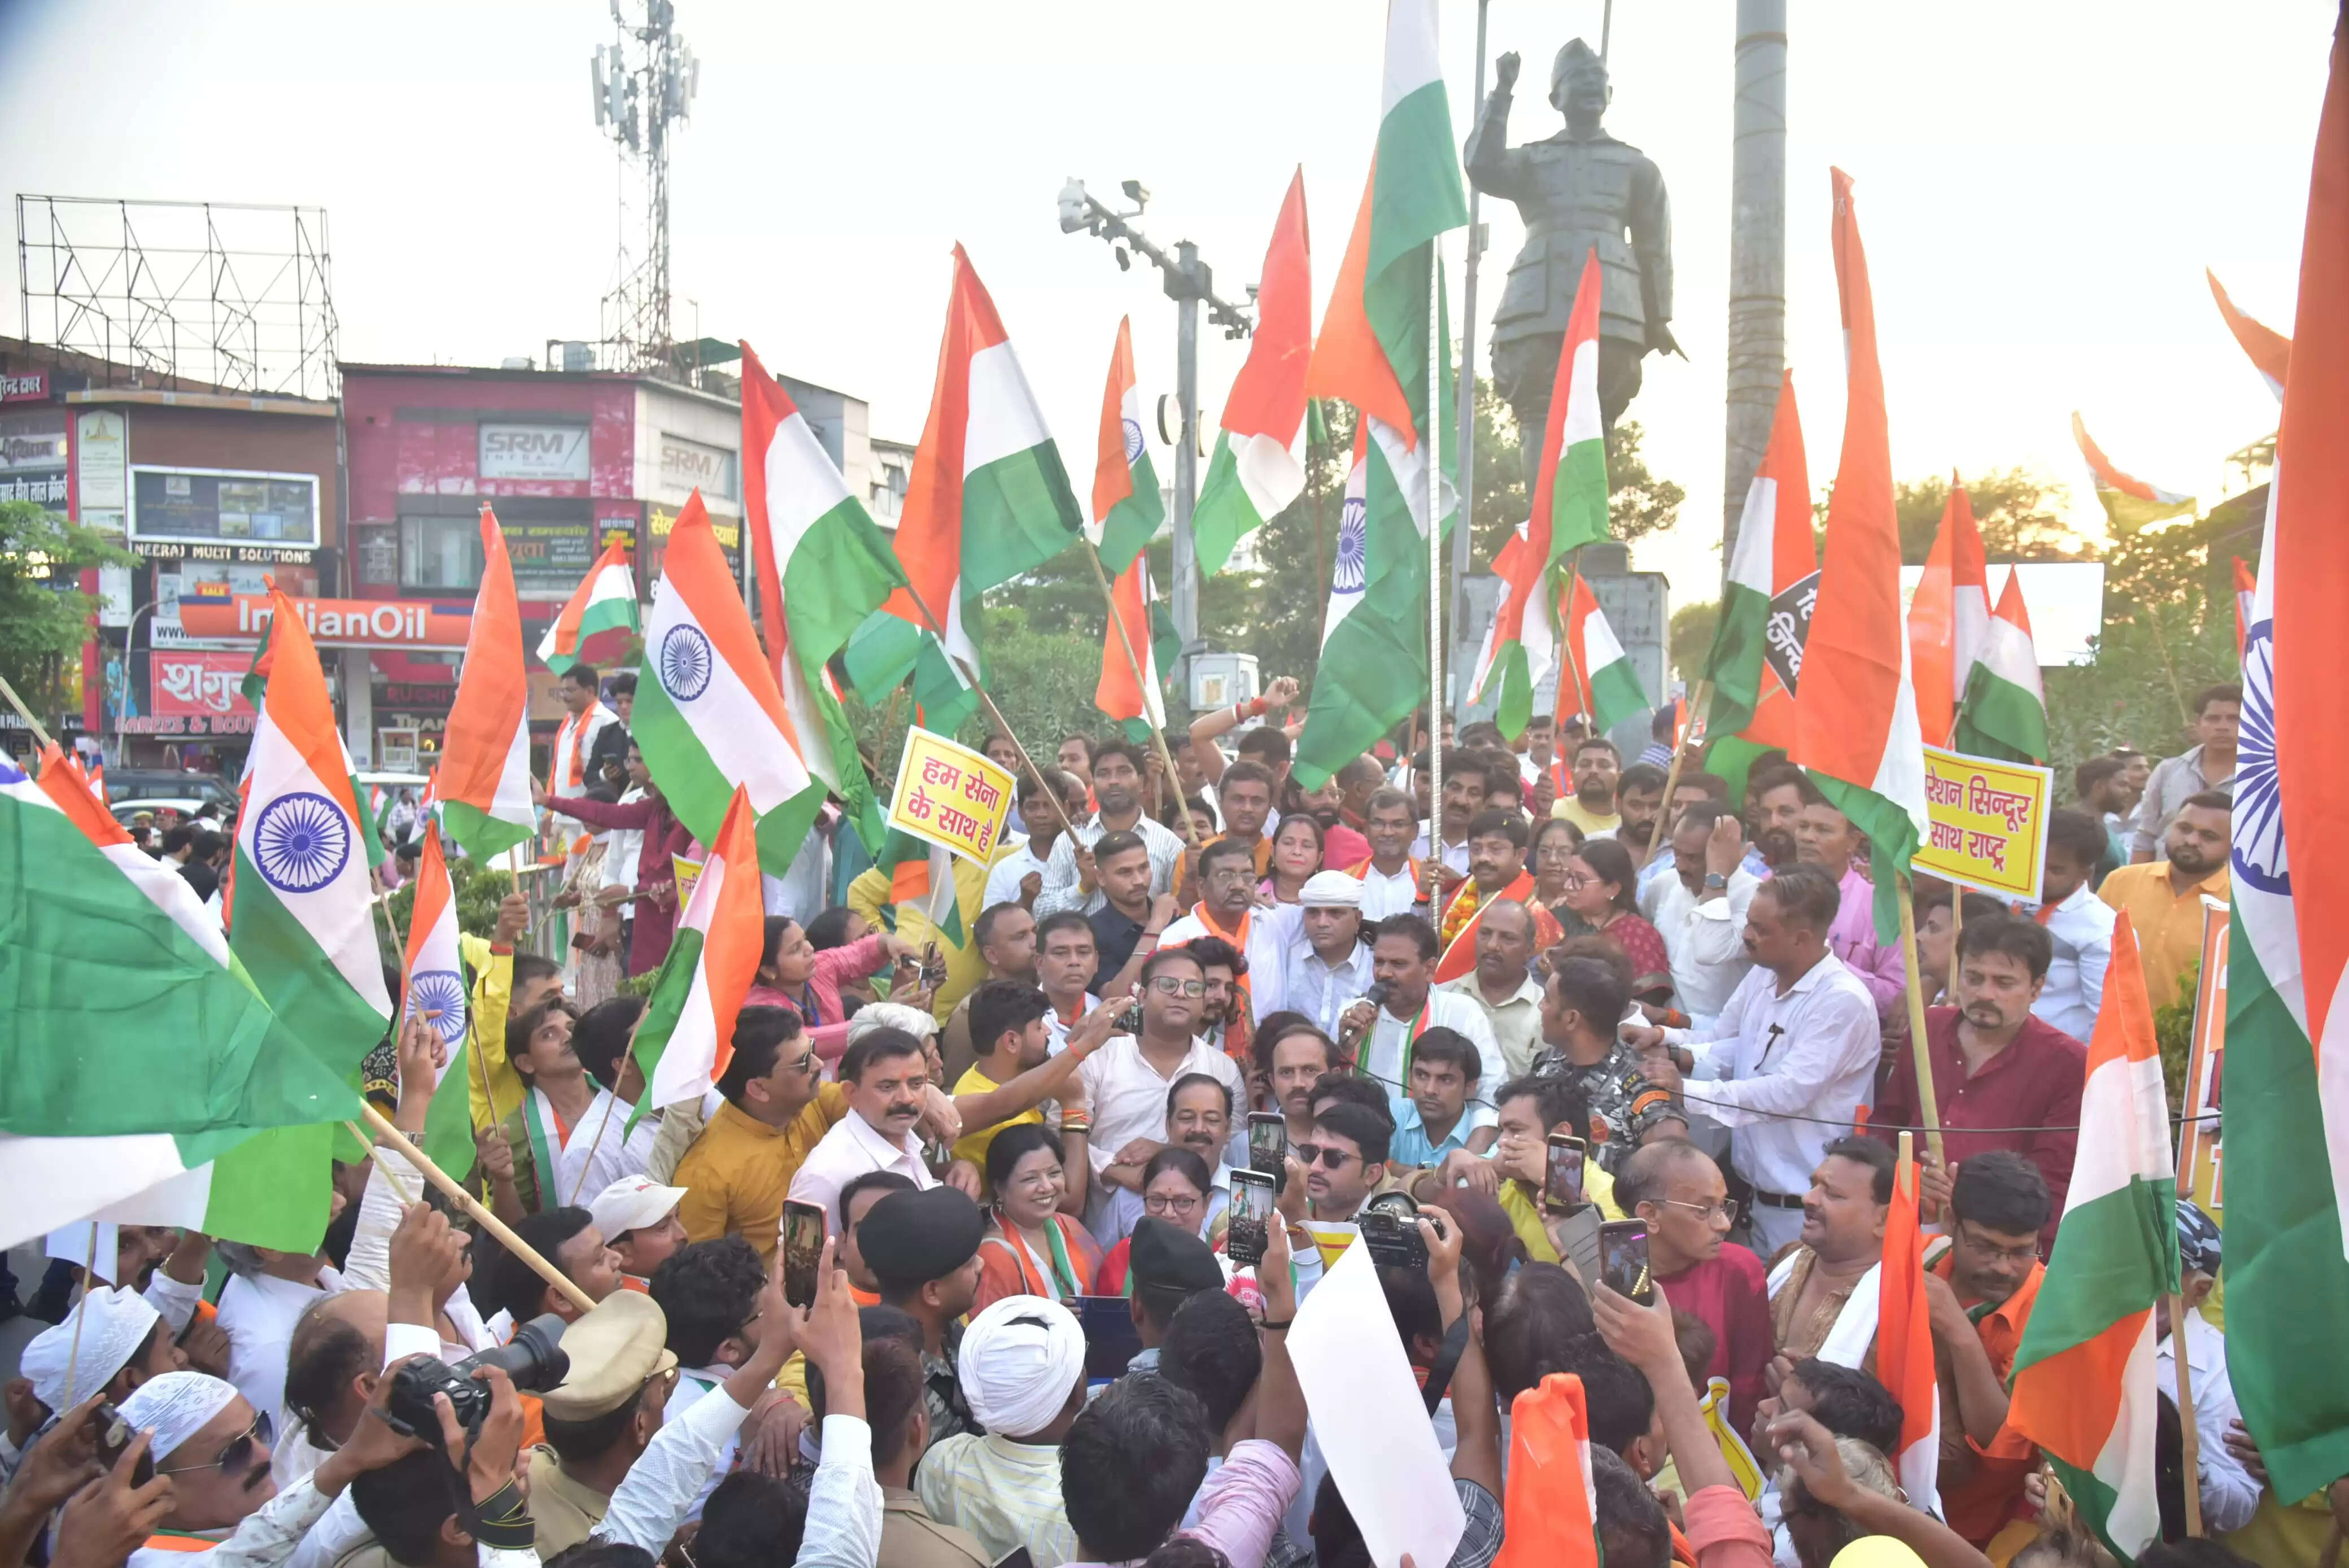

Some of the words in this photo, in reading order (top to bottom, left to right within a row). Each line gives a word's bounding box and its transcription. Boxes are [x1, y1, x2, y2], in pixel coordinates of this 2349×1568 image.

[485, 433, 564, 454] SRM
[661, 446, 711, 475] SRM
[134, 544, 185, 558] NEERAJ
[193, 545, 230, 560] MULTI
[238, 548, 311, 564] SOLUTIONS
[189, 715, 207, 733] &
[922, 755, 962, 790] हम
[964, 770, 1001, 812] सेना
[1968, 775, 2032, 832] सिन्दूर
[907, 785, 935, 819] के
[938, 804, 979, 841] साथ
[977, 818, 993, 853] है
[1931, 820, 1964, 853] साथ
[1968, 831, 2007, 872] राष्ट्र
